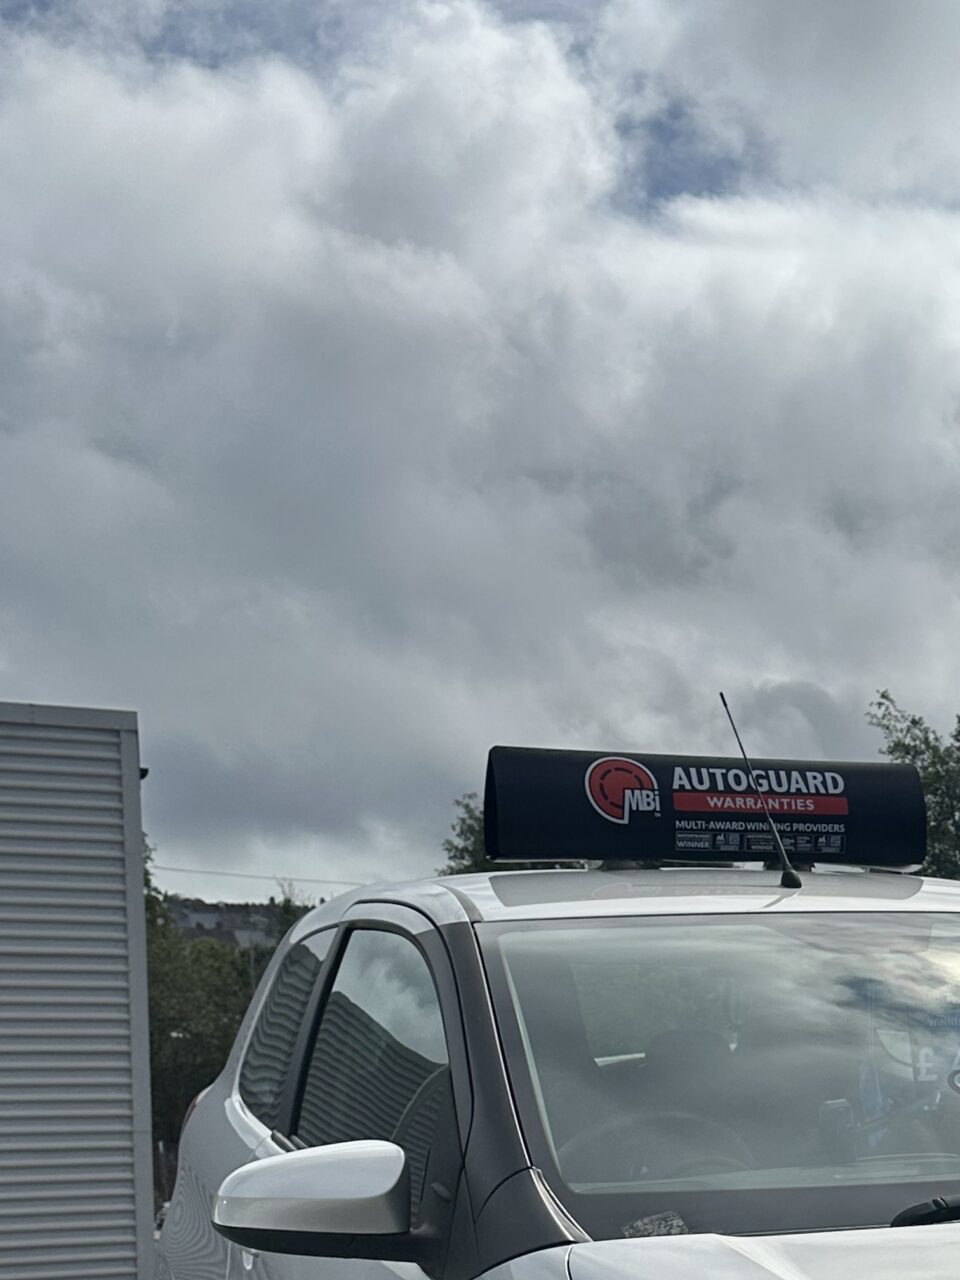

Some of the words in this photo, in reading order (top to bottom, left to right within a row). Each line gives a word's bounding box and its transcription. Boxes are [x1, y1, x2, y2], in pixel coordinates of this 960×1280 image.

[672, 766, 845, 795] AUTOGUARD
[707, 796, 815, 811] WARRANTIES
[675, 820, 745, 831] MULTI-AWARD
[792, 822, 846, 833] PROVIDERS
